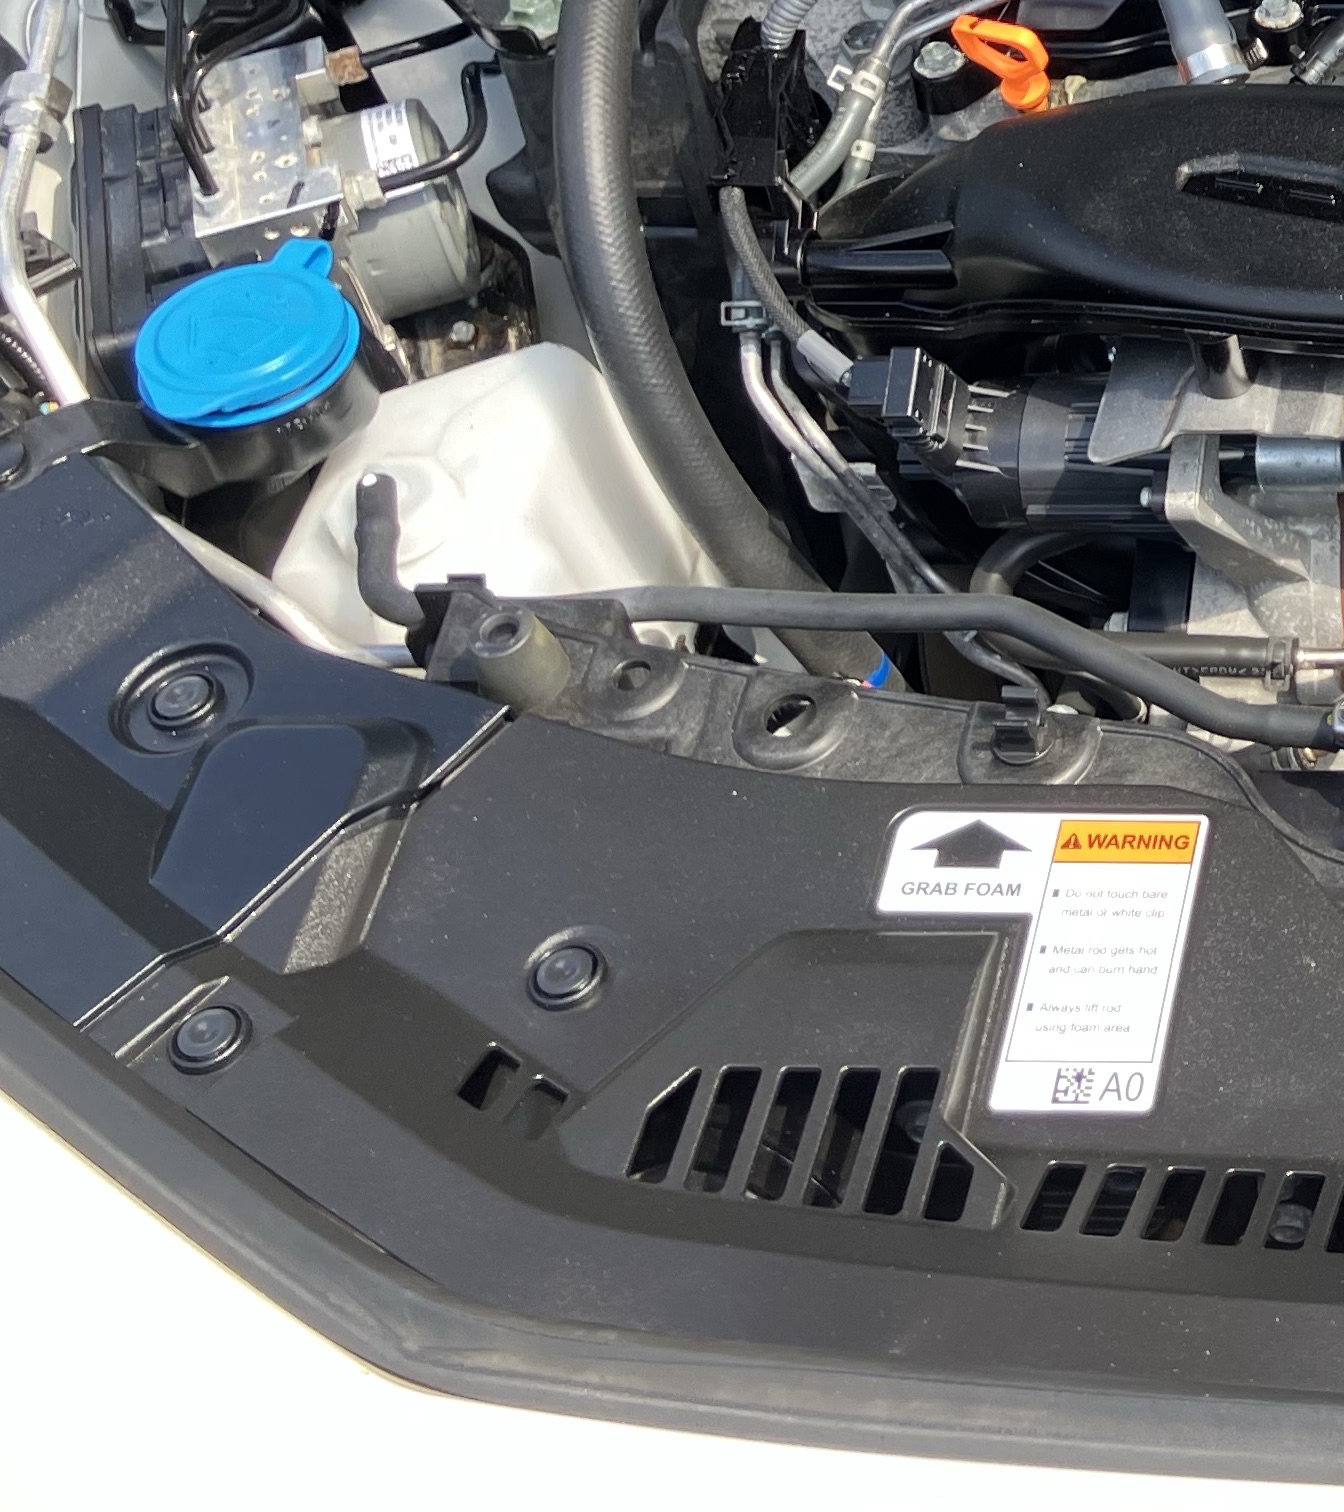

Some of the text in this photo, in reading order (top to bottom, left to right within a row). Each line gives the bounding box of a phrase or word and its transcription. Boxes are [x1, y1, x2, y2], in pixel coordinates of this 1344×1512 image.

[1088, 834, 1190, 850] WARNING
[901, 882, 1022, 897] GRAB FOAM
[1106, 889, 1138, 899] touch
[1142, 889, 1168, 899] bare
[1062, 908, 1092, 918] metal
[1112, 907, 1141, 918] white
[1145, 907, 1164, 920] clip
[1052, 946, 1158, 957] Metal rod gets hot
[1049, 965, 1070, 974] and
[1128, 964, 1158, 975] hand
[1040, 1002, 1121, 1014] Always lift rod
[1035, 1023, 1130, 1034] using foam area
[1099, 1072, 1144, 1100] A0
